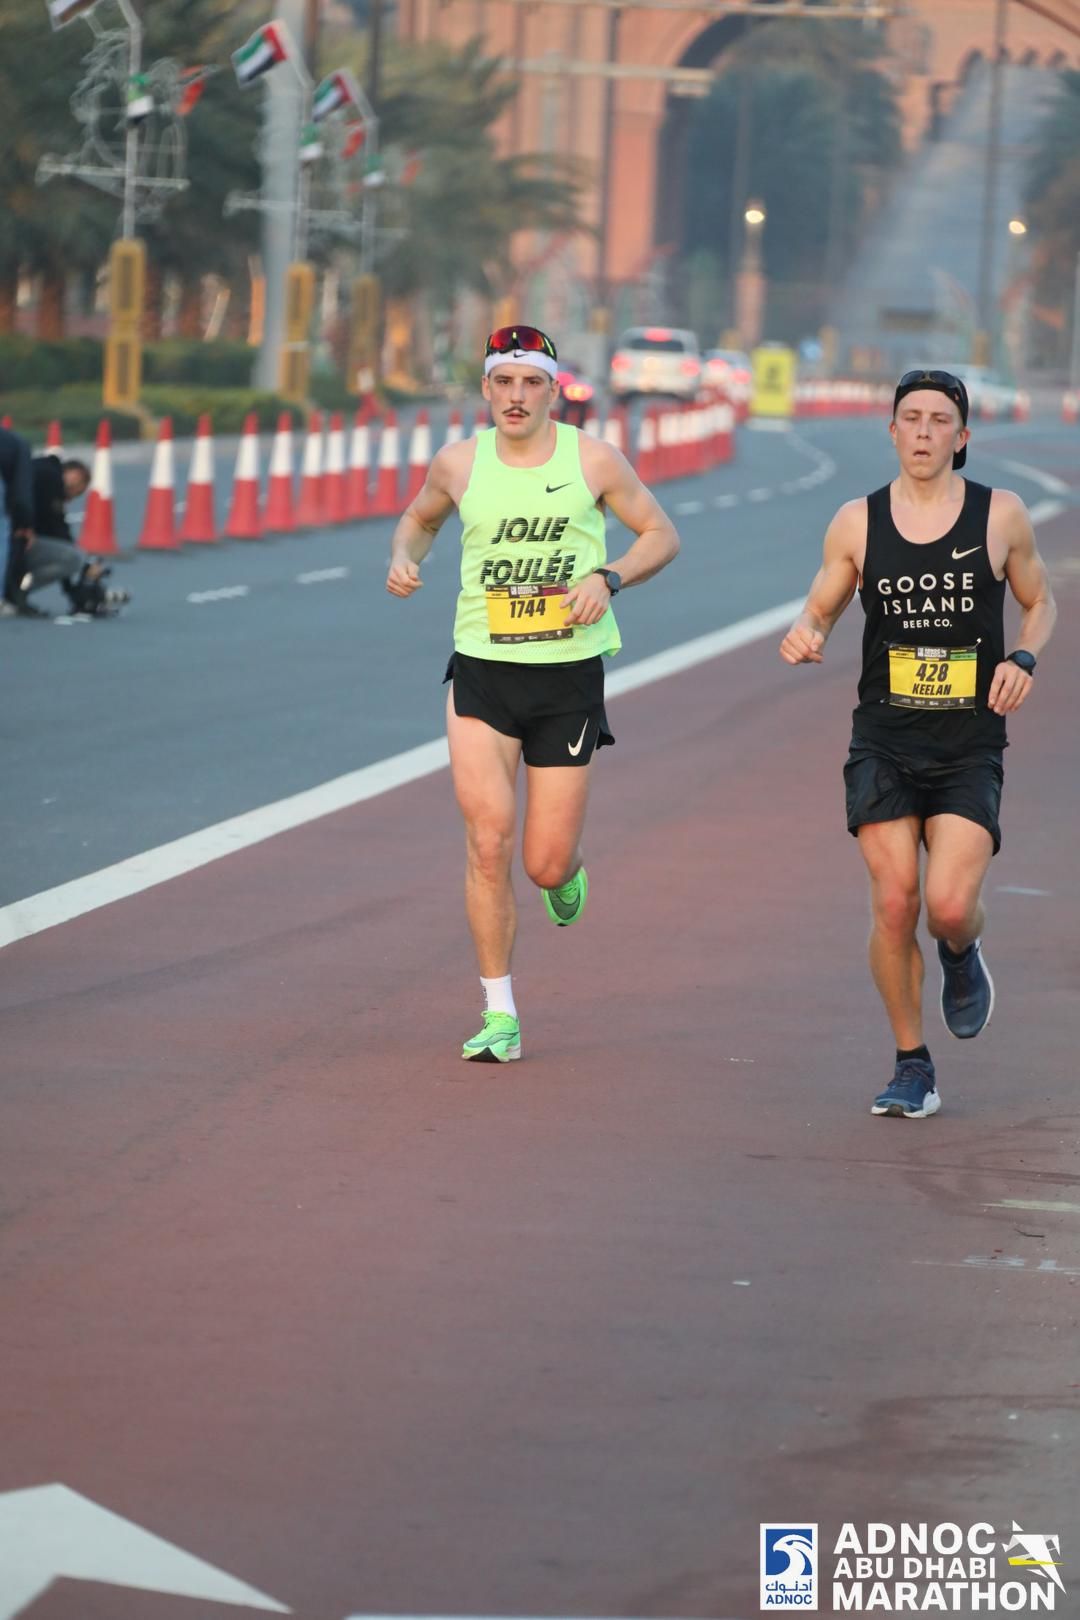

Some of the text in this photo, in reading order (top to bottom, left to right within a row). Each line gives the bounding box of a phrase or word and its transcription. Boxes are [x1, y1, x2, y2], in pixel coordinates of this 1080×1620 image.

[491, 517, 569, 544] JOLIE
[480, 549, 576, 584] FOULÉE
[877, 572, 974, 595] GOOSE
[510, 598, 546, 618] 1744
[883, 596, 974, 615] ISLAND
[903, 618, 952, 629] BEER CO.
[916, 663, 949, 682] 428
[912, 683, 951, 695] KEELAN
